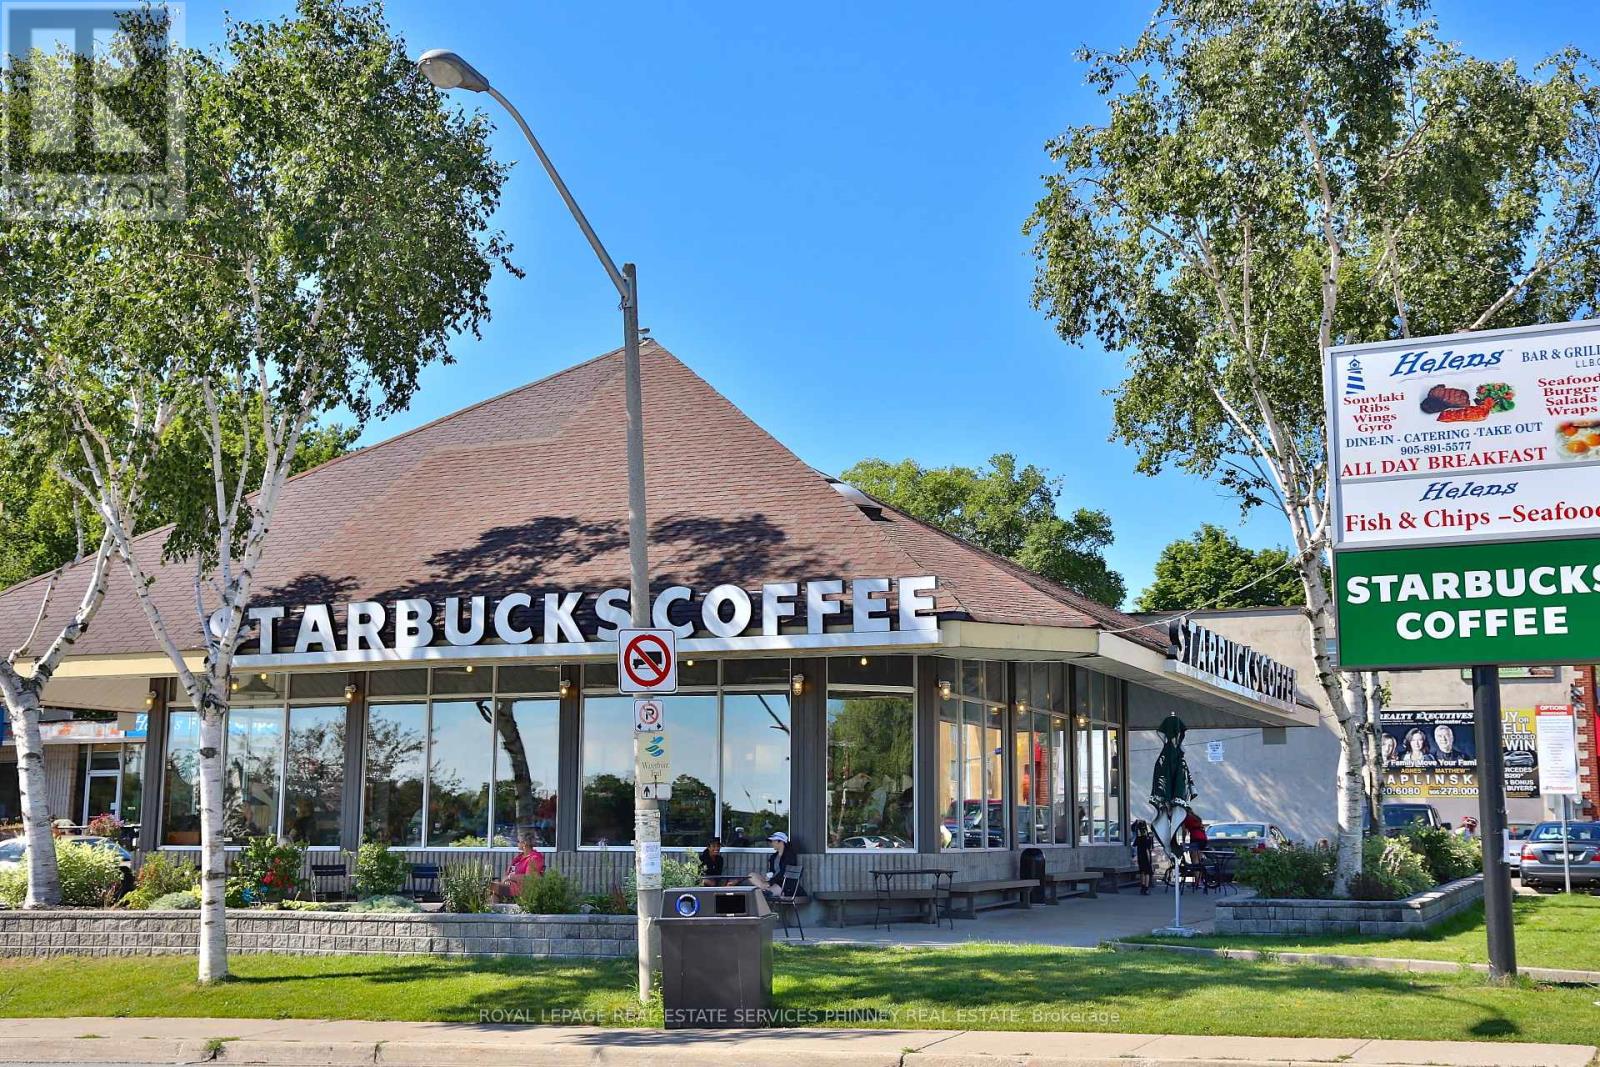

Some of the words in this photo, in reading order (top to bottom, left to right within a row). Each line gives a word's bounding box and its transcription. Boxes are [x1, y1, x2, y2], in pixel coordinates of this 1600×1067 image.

[1521, 350, 1548, 363] BAR
[1551, 348, 1561, 360] &
[1390, 349, 1504, 377] Helens
[1543, 386, 1600, 397] Burger
[1343, 392, 1405, 405] Souvlaki
[1545, 394, 1598, 407] Salads
[1359, 404, 1390, 413] Ribs
[1546, 406, 1598, 416] Wraps
[1353, 413, 1397, 424] Wings
[1345, 434, 1394, 448] DINE-IN
[1403, 428, 1470, 443] CATERING
[1515, 421, 1543, 434] OUT
[1357, 423, 1393, 434] Gyro
[1400, 441, 1471, 455] 905-891-5577
[1341, 461, 1377, 477] ALL
[1381, 457, 1420, 474] DAY
[1428, 446, 1547, 470] BREAKFAST
[1419, 481, 1519, 502] Helens
[1345, 512, 1392, 532] Fish
[1398, 511, 1417, 529] &
[1423, 509, 1490, 531] Chips
[1396, 606, 1569, 640] COFFEE
[1416, 712, 1474, 721] EXECUTIVES
[1505, 740, 1535, 751] WIN
